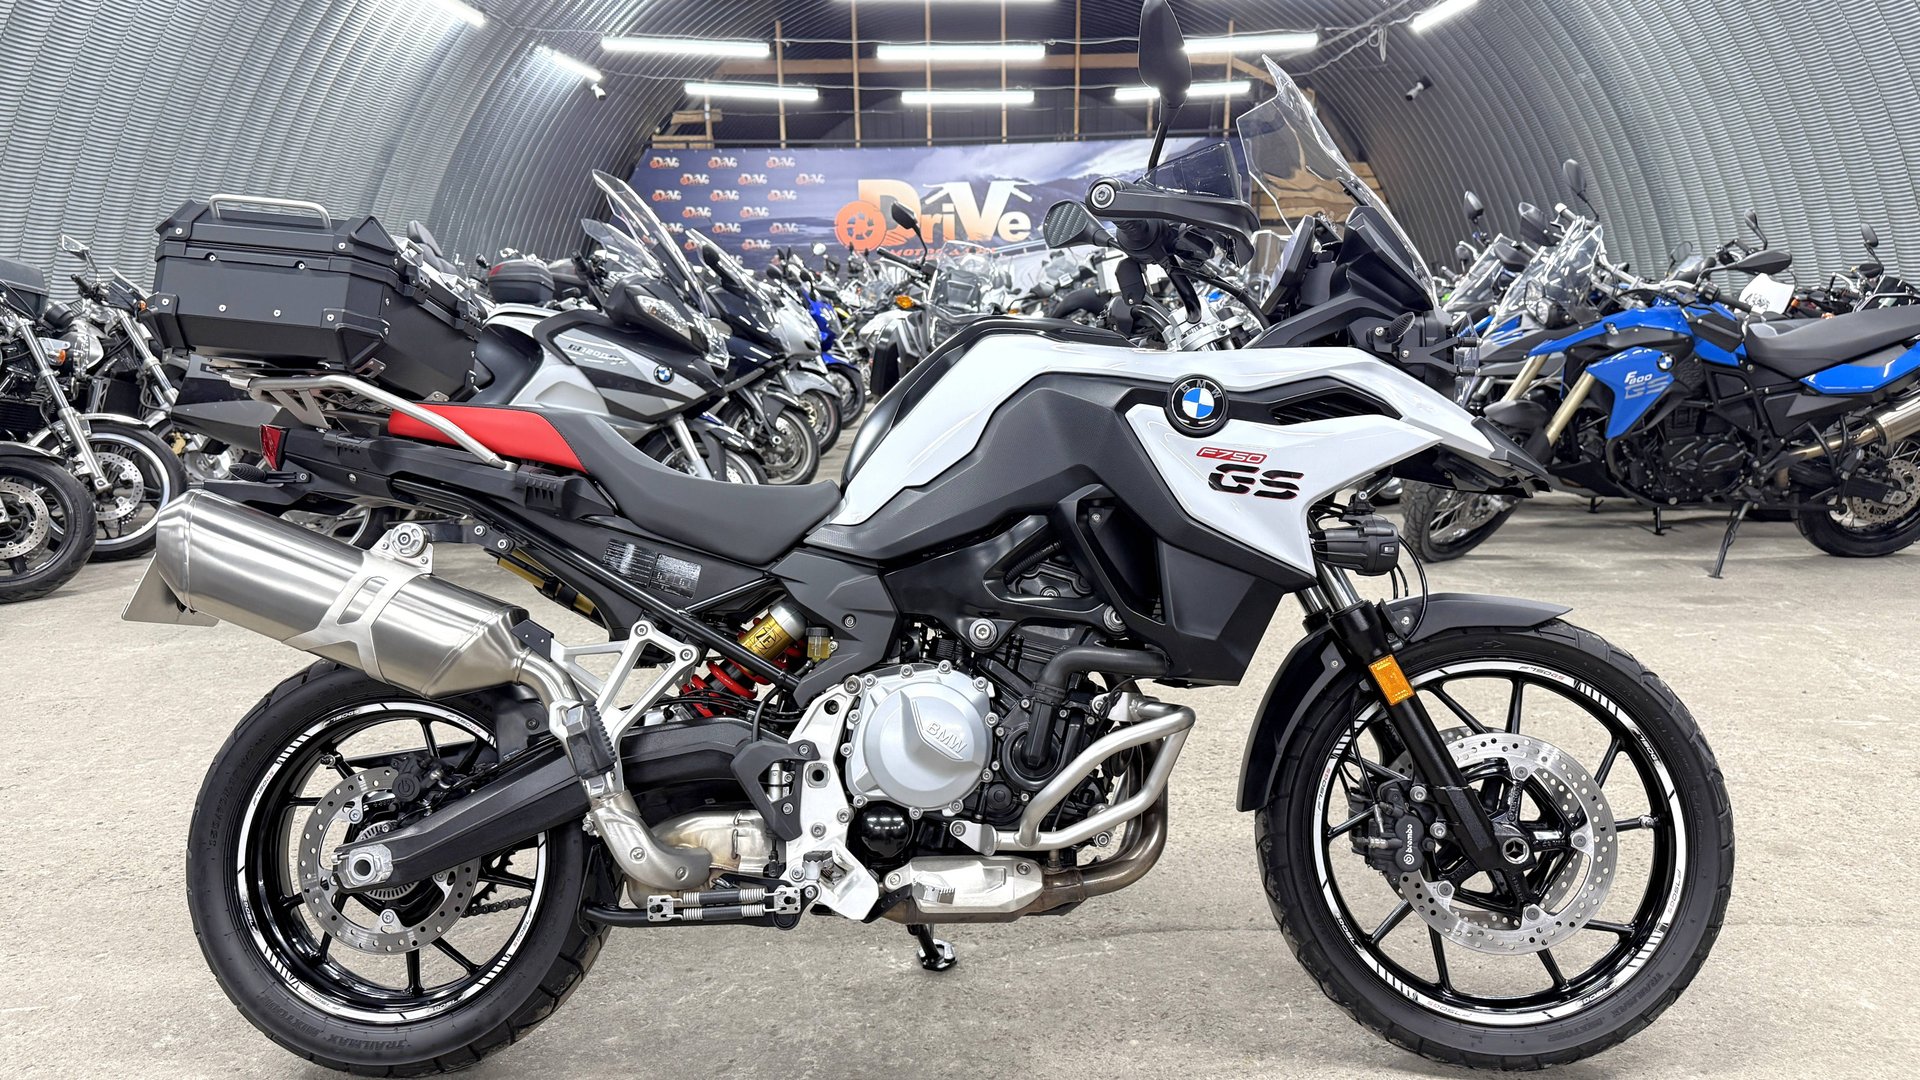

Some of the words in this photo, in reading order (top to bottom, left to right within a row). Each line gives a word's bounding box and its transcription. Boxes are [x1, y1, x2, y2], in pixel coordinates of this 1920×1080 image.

[858, 179, 1032, 244] DriVe
[1179, 379, 1222, 399] BMW
[1624, 371, 1653, 385] F800
[1625, 375, 1670, 399] GS
[1198, 448, 1266, 464] F750
[1208, 464, 1304, 499] GS
[1518, 665, 1566, 681] F750GS
[926, 722, 968, 753] BMW
[1405, 823, 1413, 854] brembo
